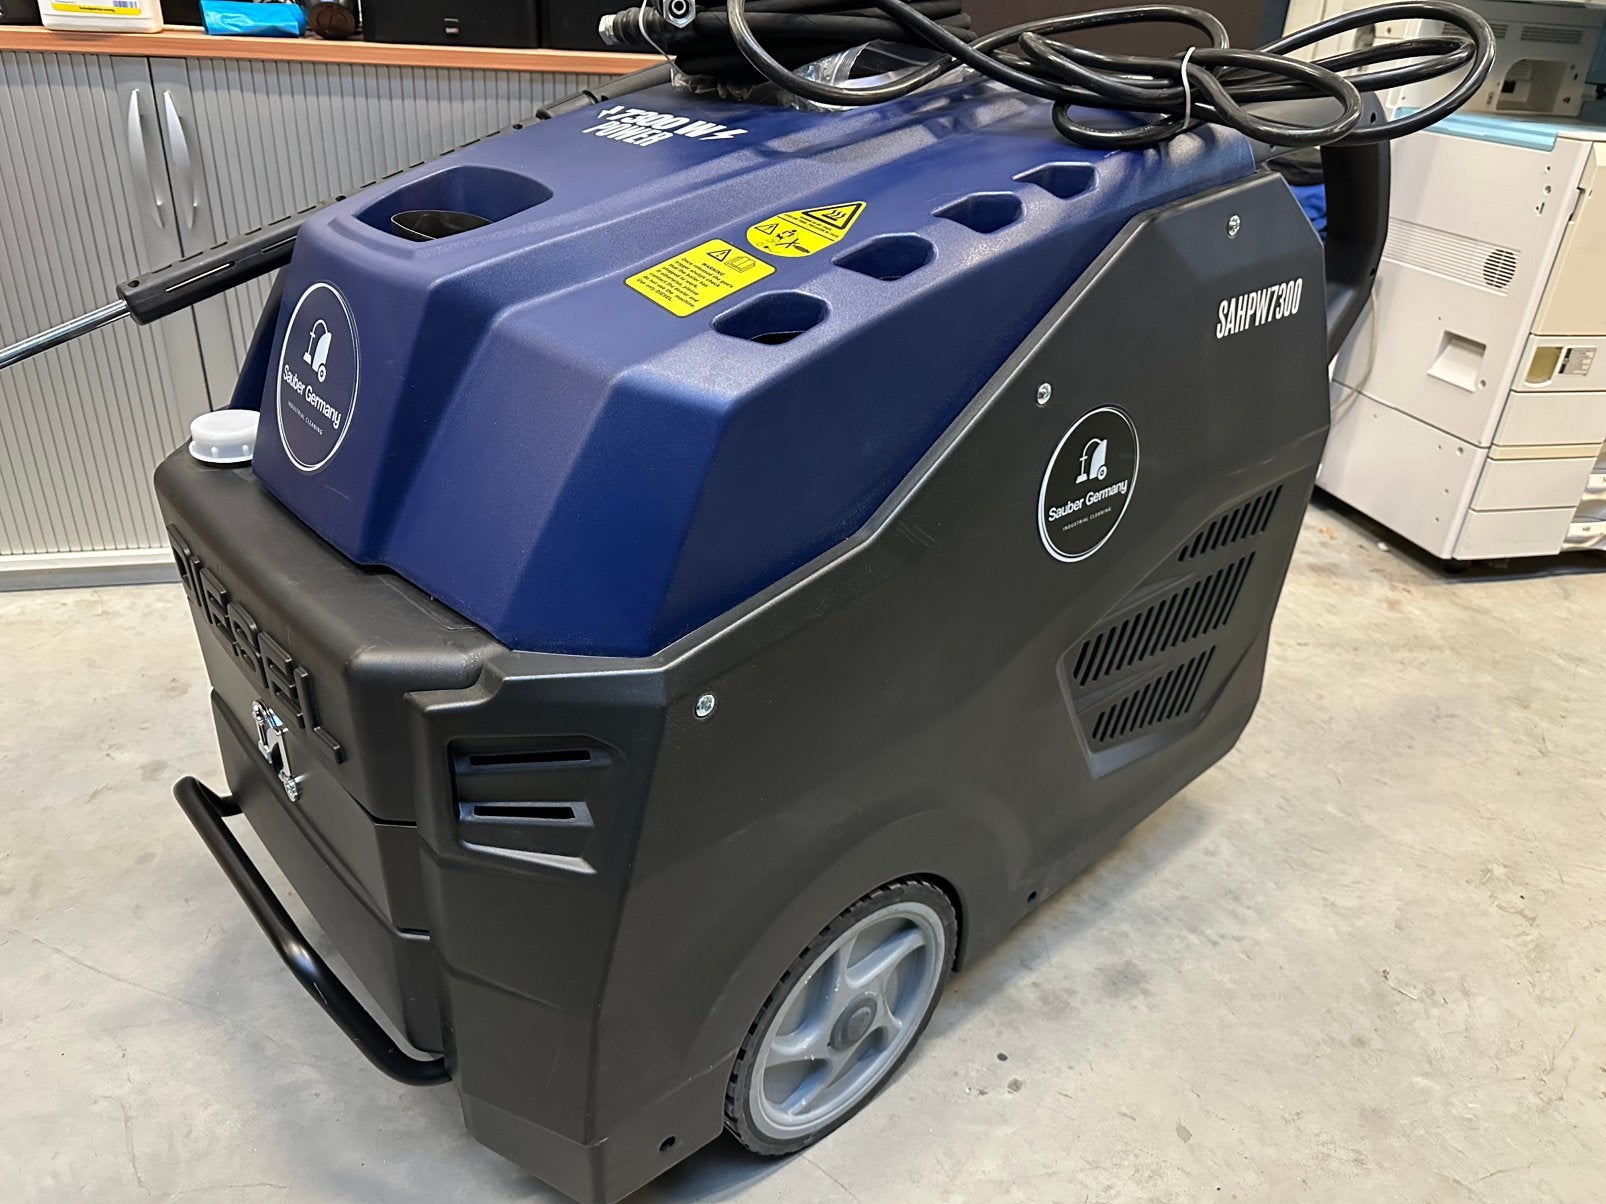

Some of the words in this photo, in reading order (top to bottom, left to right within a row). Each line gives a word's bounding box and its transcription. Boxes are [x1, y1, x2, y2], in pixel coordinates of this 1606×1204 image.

[582, 121, 674, 147] POWER
[606, 108, 690, 130] 7300
[673, 120, 727, 138] W
[688, 269, 707, 279] always
[705, 278, 721, 287] check
[692, 264, 714, 276] released
[1216, 277, 1303, 339] SAHPW7300
[282, 364, 306, 395] Sauber
[304, 384, 342, 430] Germany
[305, 416, 323, 436] CLEANING
[1048, 497, 1085, 522] Sauber
[1085, 479, 1128, 506] Germany
[1062, 517, 1089, 532] INDUSTRIAL
[1089, 506, 1112, 519] CLEANING
[166, 523, 346, 764] DIESEL
